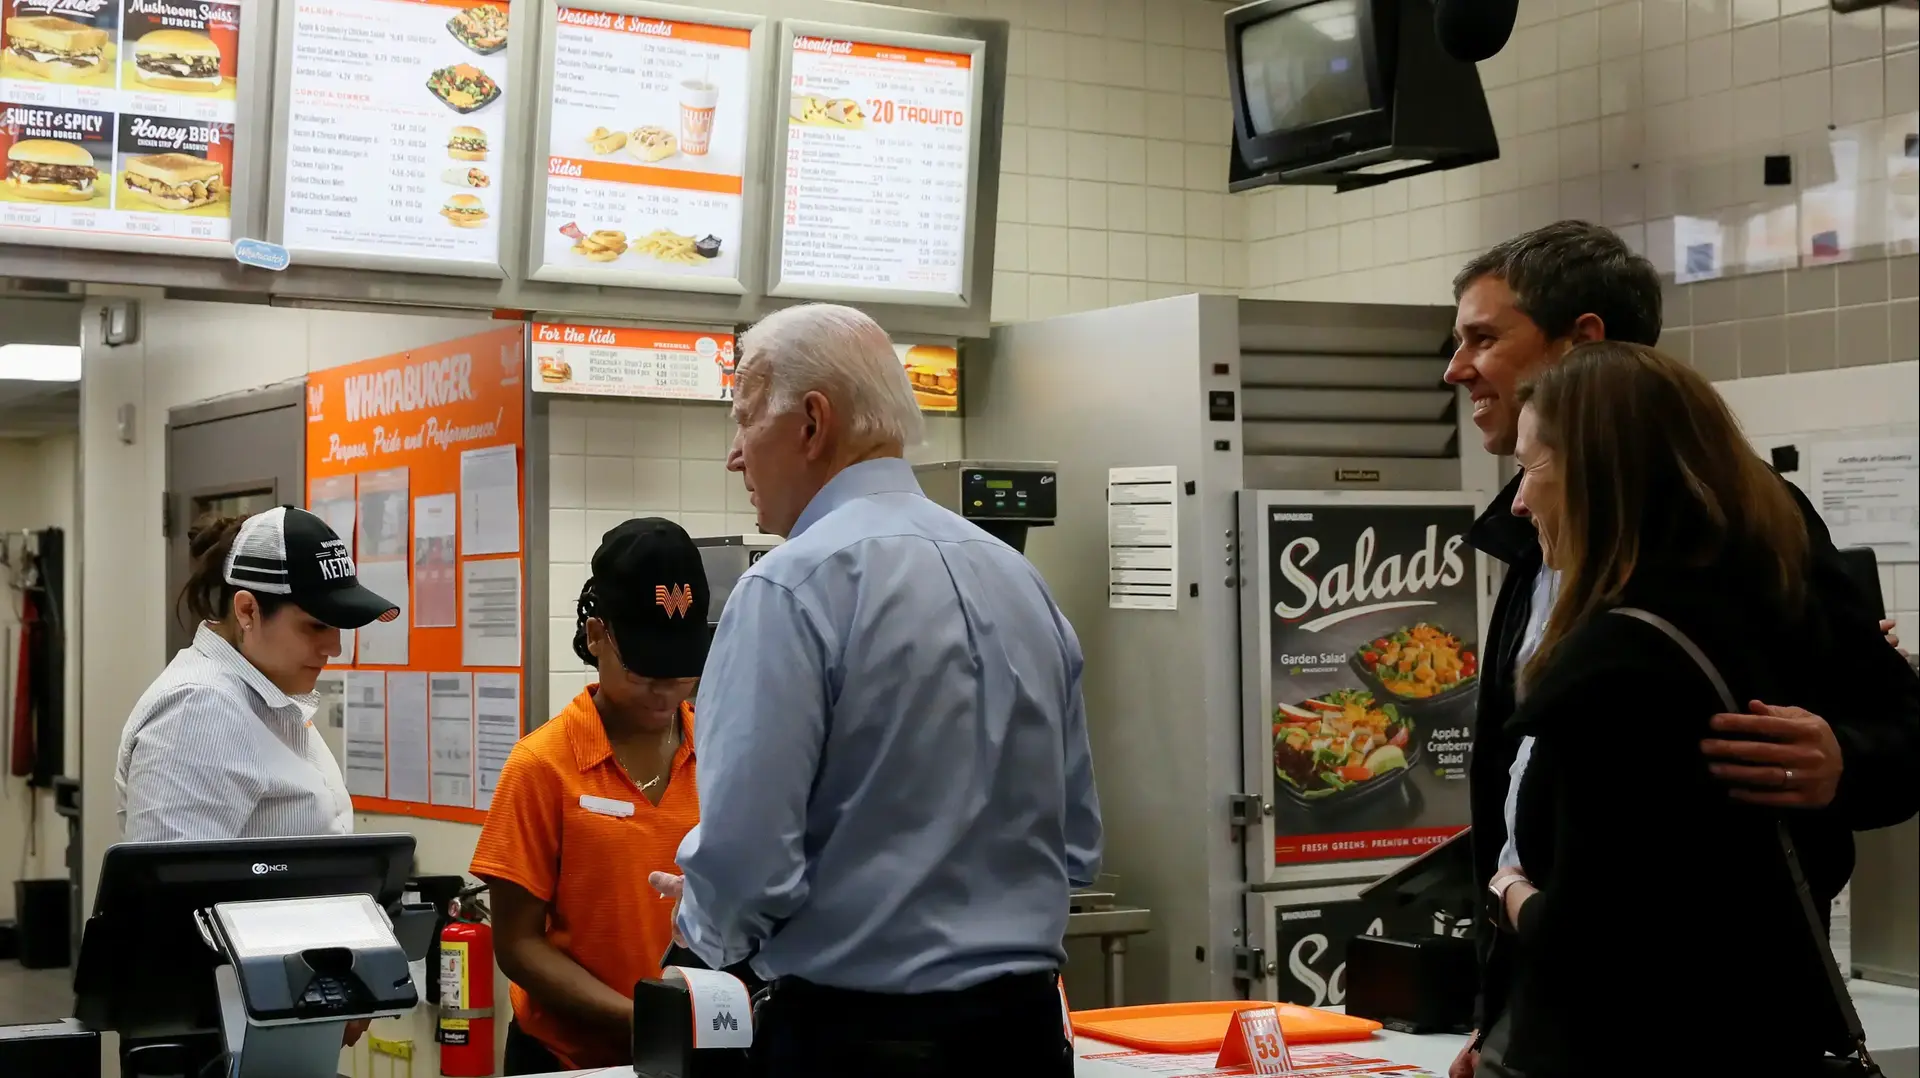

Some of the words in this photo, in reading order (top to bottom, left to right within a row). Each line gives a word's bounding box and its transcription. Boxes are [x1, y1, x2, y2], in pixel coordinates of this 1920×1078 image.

[128, 0, 198, 19] Mushroom
[199, 4, 232, 22] Swiss
[161, 17, 204, 30] BURGER
[557, 8, 612, 28] Desserts
[614, 15, 625, 30] &
[628, 17, 672, 36] Snacks
[7, 108, 54, 127] SWEET
[53, 114, 63, 127] &
[64, 113, 103, 132] SPICY
[898, 105, 964, 127] TAQUITO
[26, 127, 52, 137] BACON
[53, 131, 82, 140] BURGER
[130, 118, 189, 149] Honey
[189, 126, 220, 145] BBQ
[548, 158, 583, 177] Sides
[539, 325, 561, 341] For
[564, 327, 585, 343] the
[588, 329, 616, 344] Kids
[344, 353, 472, 421] WHATABURGER
[373, 425, 401, 455] Pride
[403, 424, 426, 450] and
[1274, 525, 1464, 620] Salads
[1281, 653, 1318, 665] Garden
[1319, 652, 1347, 664] Salad
[1431, 728, 1460, 740] Apple
[1462, 726, 1470, 738] &
[1427, 741, 1474, 753] Cranberry
[1437, 752, 1464, 764] Salad
[1302, 843, 1328, 852] FRESH
[1372, 838, 1409, 848] PREMIUM
[1254, 1034, 1280, 1059] 53
